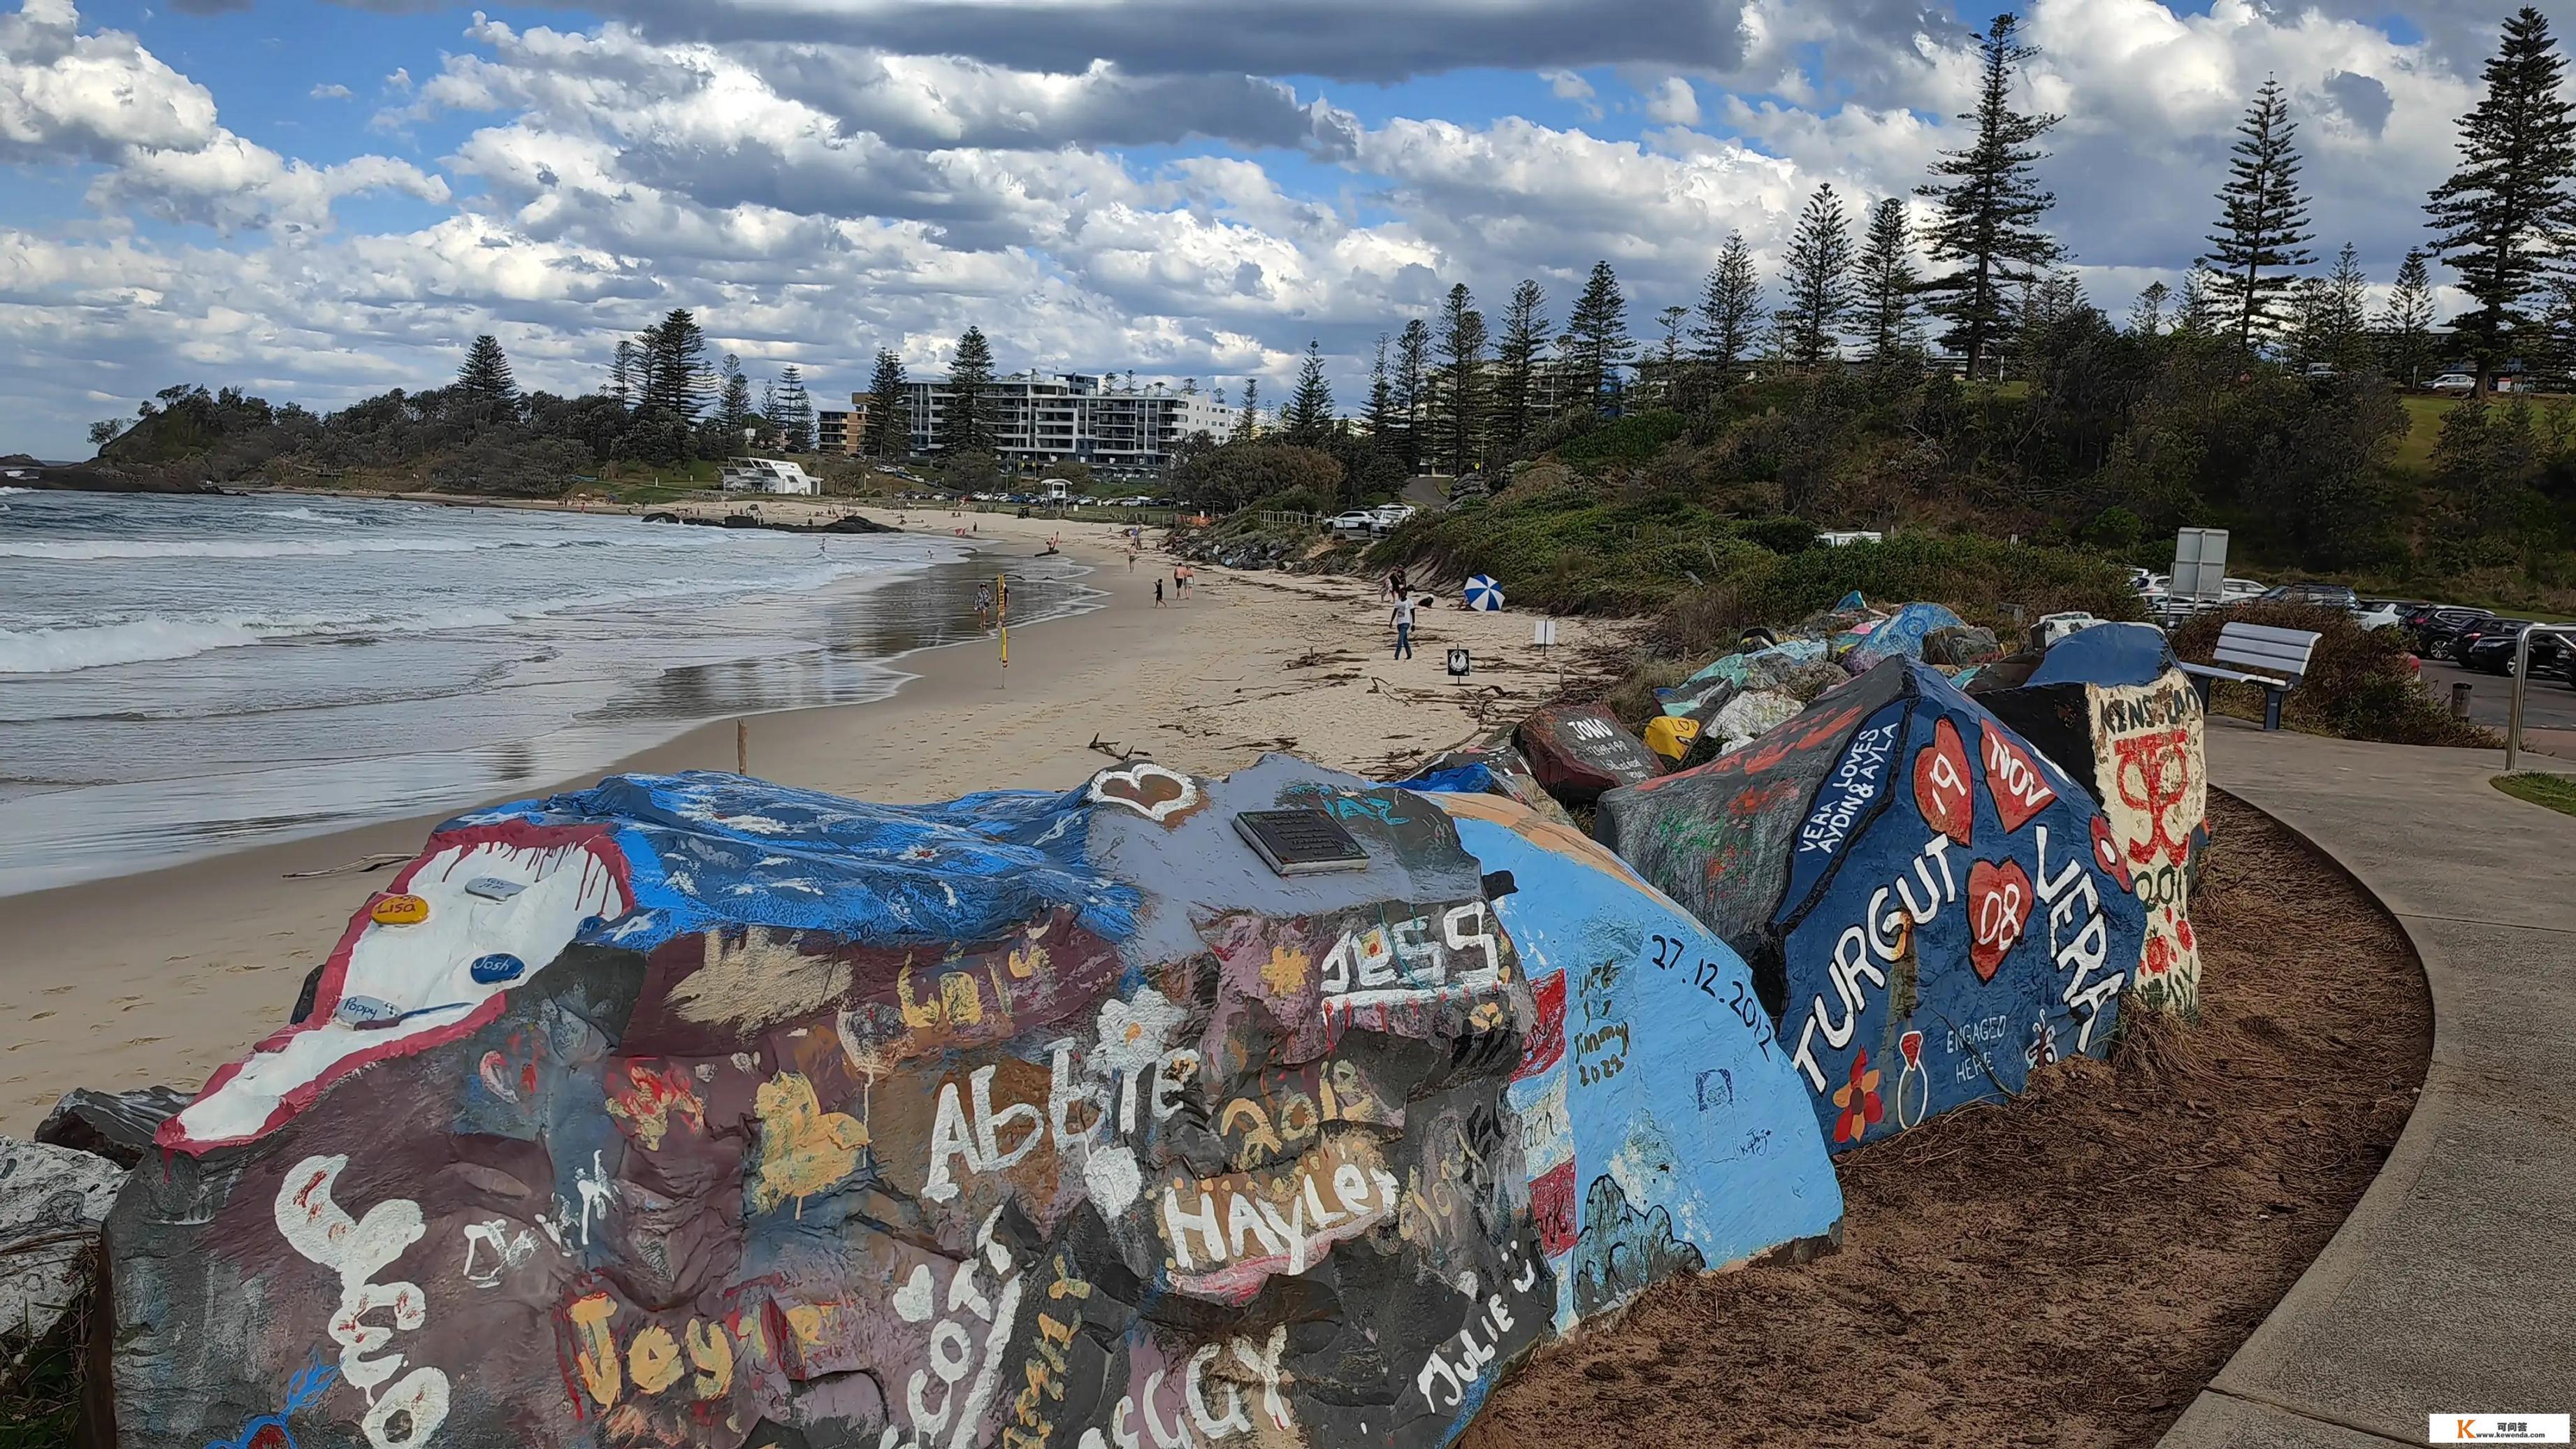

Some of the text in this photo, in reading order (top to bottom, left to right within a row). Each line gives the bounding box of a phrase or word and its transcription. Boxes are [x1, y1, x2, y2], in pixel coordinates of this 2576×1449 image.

[1567, 719, 1613, 740] JONO
[1832, 728, 1881, 789] LOVES
[1930, 734, 2052, 816] 19 NOV
[1817, 722, 1898, 853] AYDIN & AYLA
[377, 901, 416, 914] Lisa
[1978, 882, 2022, 953] 08
[2034, 825, 2126, 1053] VERA
[473, 957, 509, 972] Josh
[1793, 834, 1958, 1094] TURGUT
[343, 997, 378, 1019] Poppy
[1947, 1015, 2006, 1053] ENGAGED
[1955, 1051, 1995, 1084] HERE
